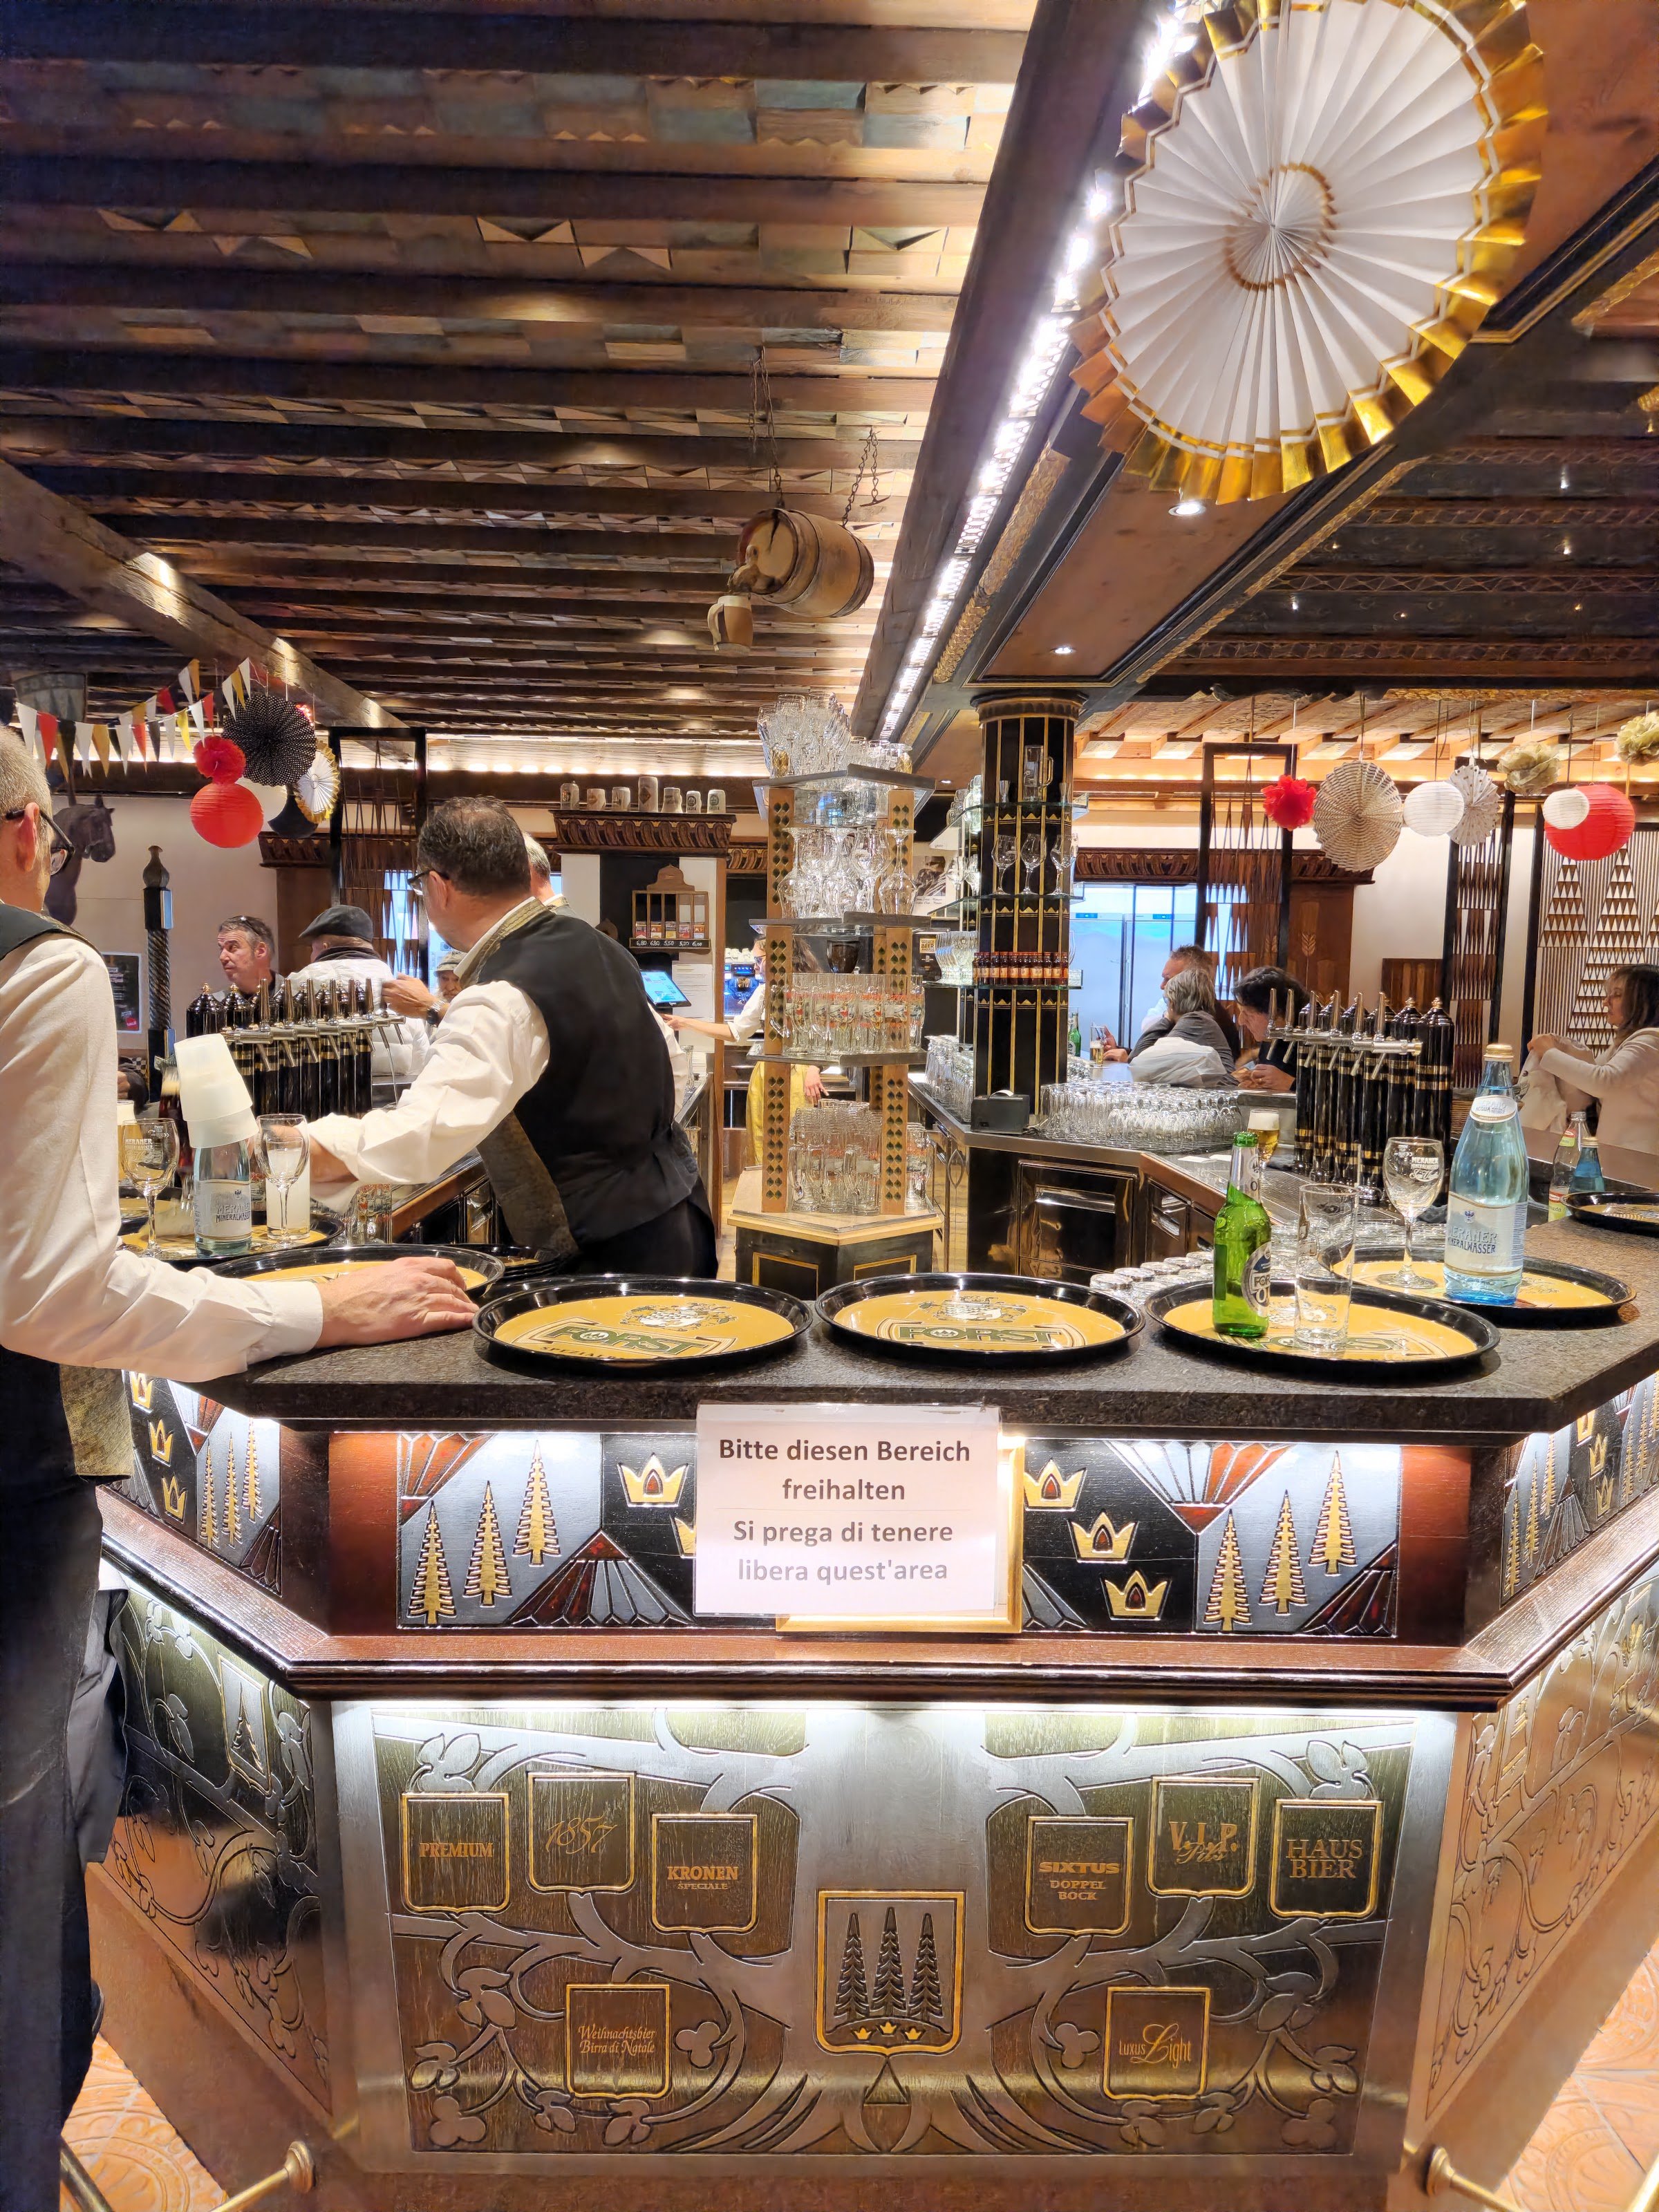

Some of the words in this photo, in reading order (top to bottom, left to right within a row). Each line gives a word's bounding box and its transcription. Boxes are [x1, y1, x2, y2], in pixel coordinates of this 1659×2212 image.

[545, 1325, 710, 1356] FORST
[898, 1326, 1062, 1344] FORST
[720, 1439, 778, 1460] Bitte
[787, 1440, 868, 1461] diesen
[877, 1441, 970, 1461] Bereich
[782, 1479, 905, 1500] freihalten
[733, 1521, 753, 1541] Si
[763, 1525, 832, 1547] prega
[841, 1521, 863, 1542] di
[871, 1524, 953, 1542] tenere
[738, 1559, 808, 1581] libera
[817, 1559, 947, 1585] quest'area
[545, 1816, 617, 1854] 1857
[420, 1843, 494, 1857] PREMIUM
[1286, 1839, 1362, 1859] HAUS
[667, 1866, 739, 1880] KRONEN
[1039, 1862, 1120, 1874] SIXTUS
[1289, 1859, 1357, 1879] BIER
[1050, 1880, 1107, 1889] DOPPEL
[1058, 1891, 1099, 1900] BOCK
[578, 2024, 656, 2040] Weihnachtsbier
[580, 2040, 608, 2054] Birra
[610, 2041, 620, 2053] di
[621, 2040, 655, 2056] Natale
[1130, 2023, 1192, 2069] Light
